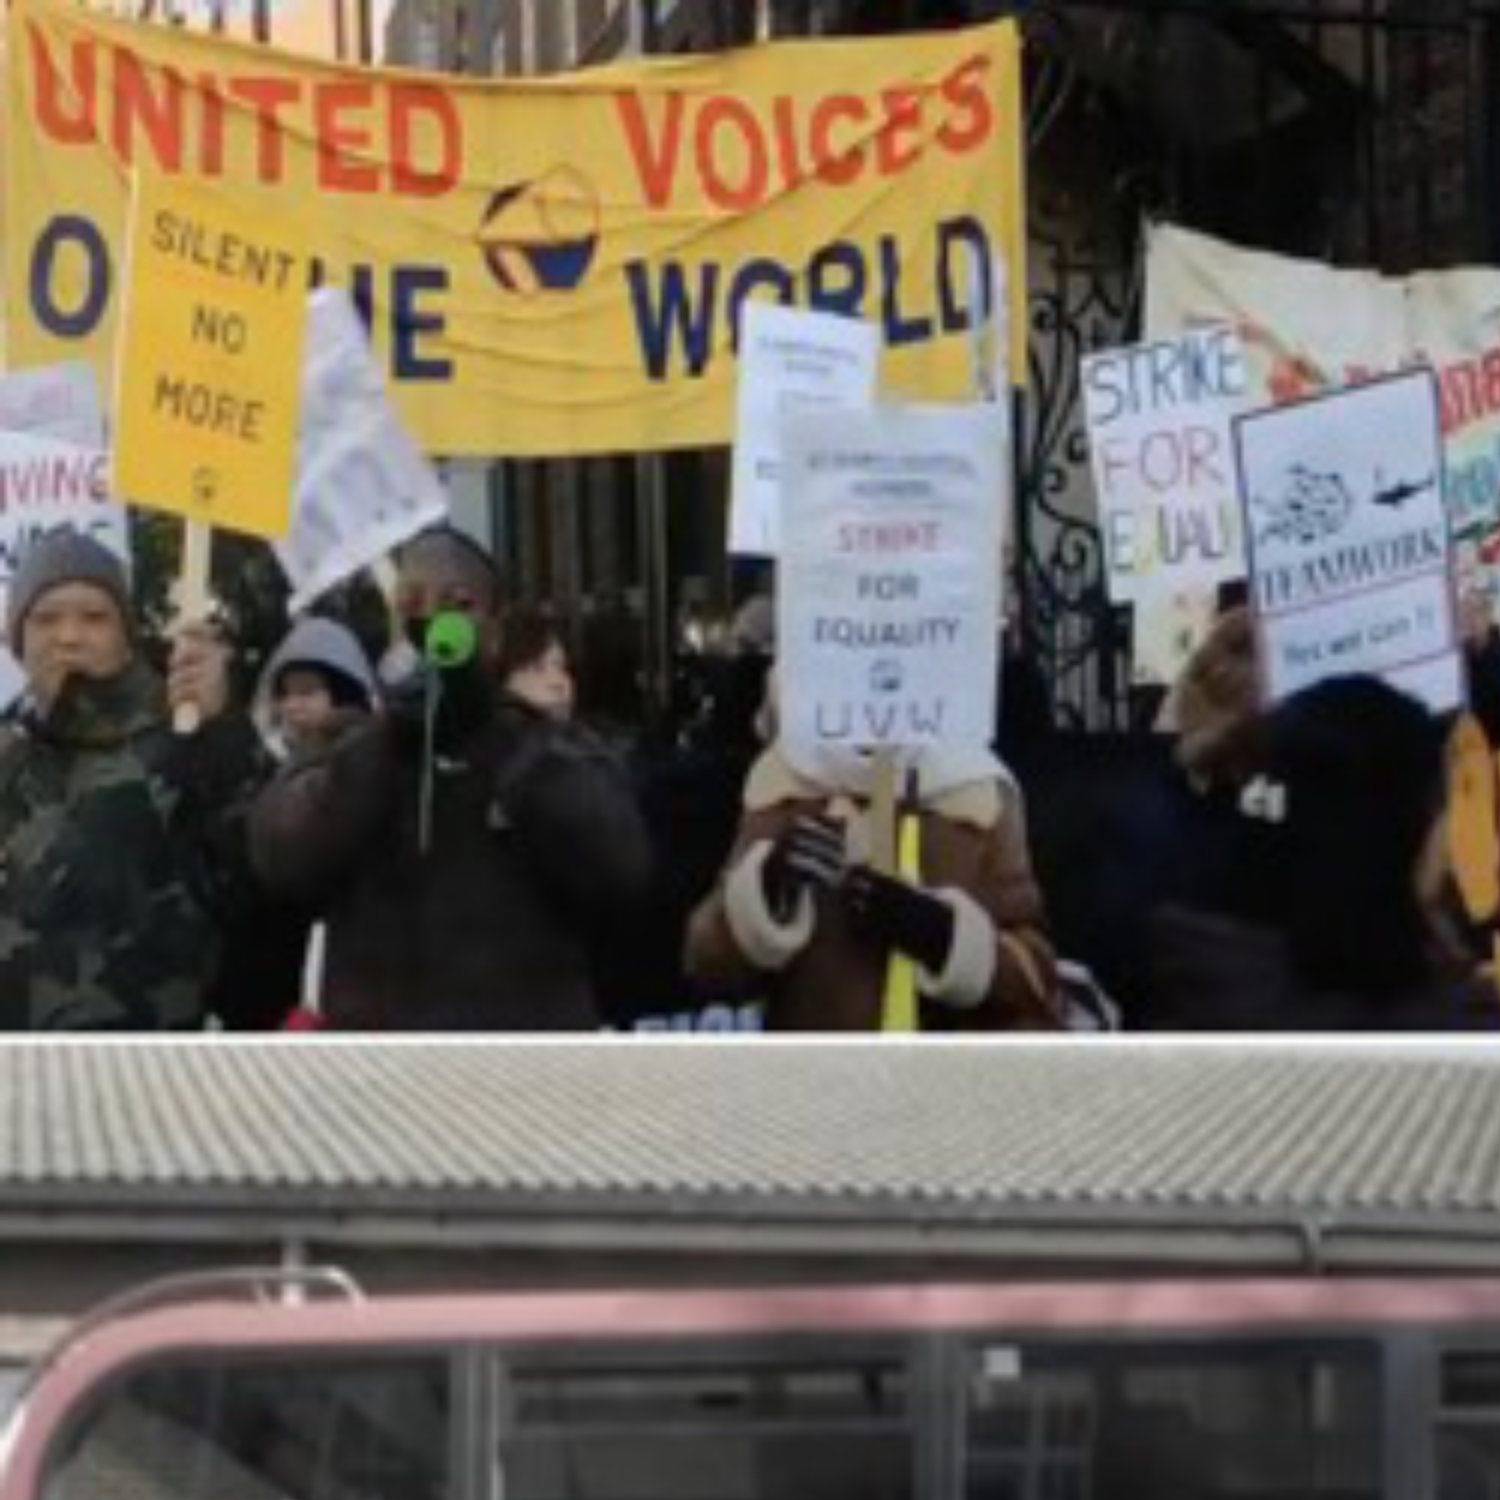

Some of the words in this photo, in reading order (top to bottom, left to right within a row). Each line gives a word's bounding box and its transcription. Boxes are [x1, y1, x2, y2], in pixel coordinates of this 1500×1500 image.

[25, 20, 464, 197] UNITED
[612, 55, 996, 212] VOICES
[151, 209, 296, 291] SILENT
[190, 306, 246, 355] NO
[624, 214, 996, 383] WORLD
[155, 374, 265, 443] MORE
[1088, 328, 1245, 427] STRIKE
[1101, 424, 1226, 494] FOR
[838, 520, 942, 554] STRIKE
[1258, 527, 1441, 608] TEAMWORK
[857, 573, 919, 602] FOR
[813, 616, 961, 650] EQUALITY
